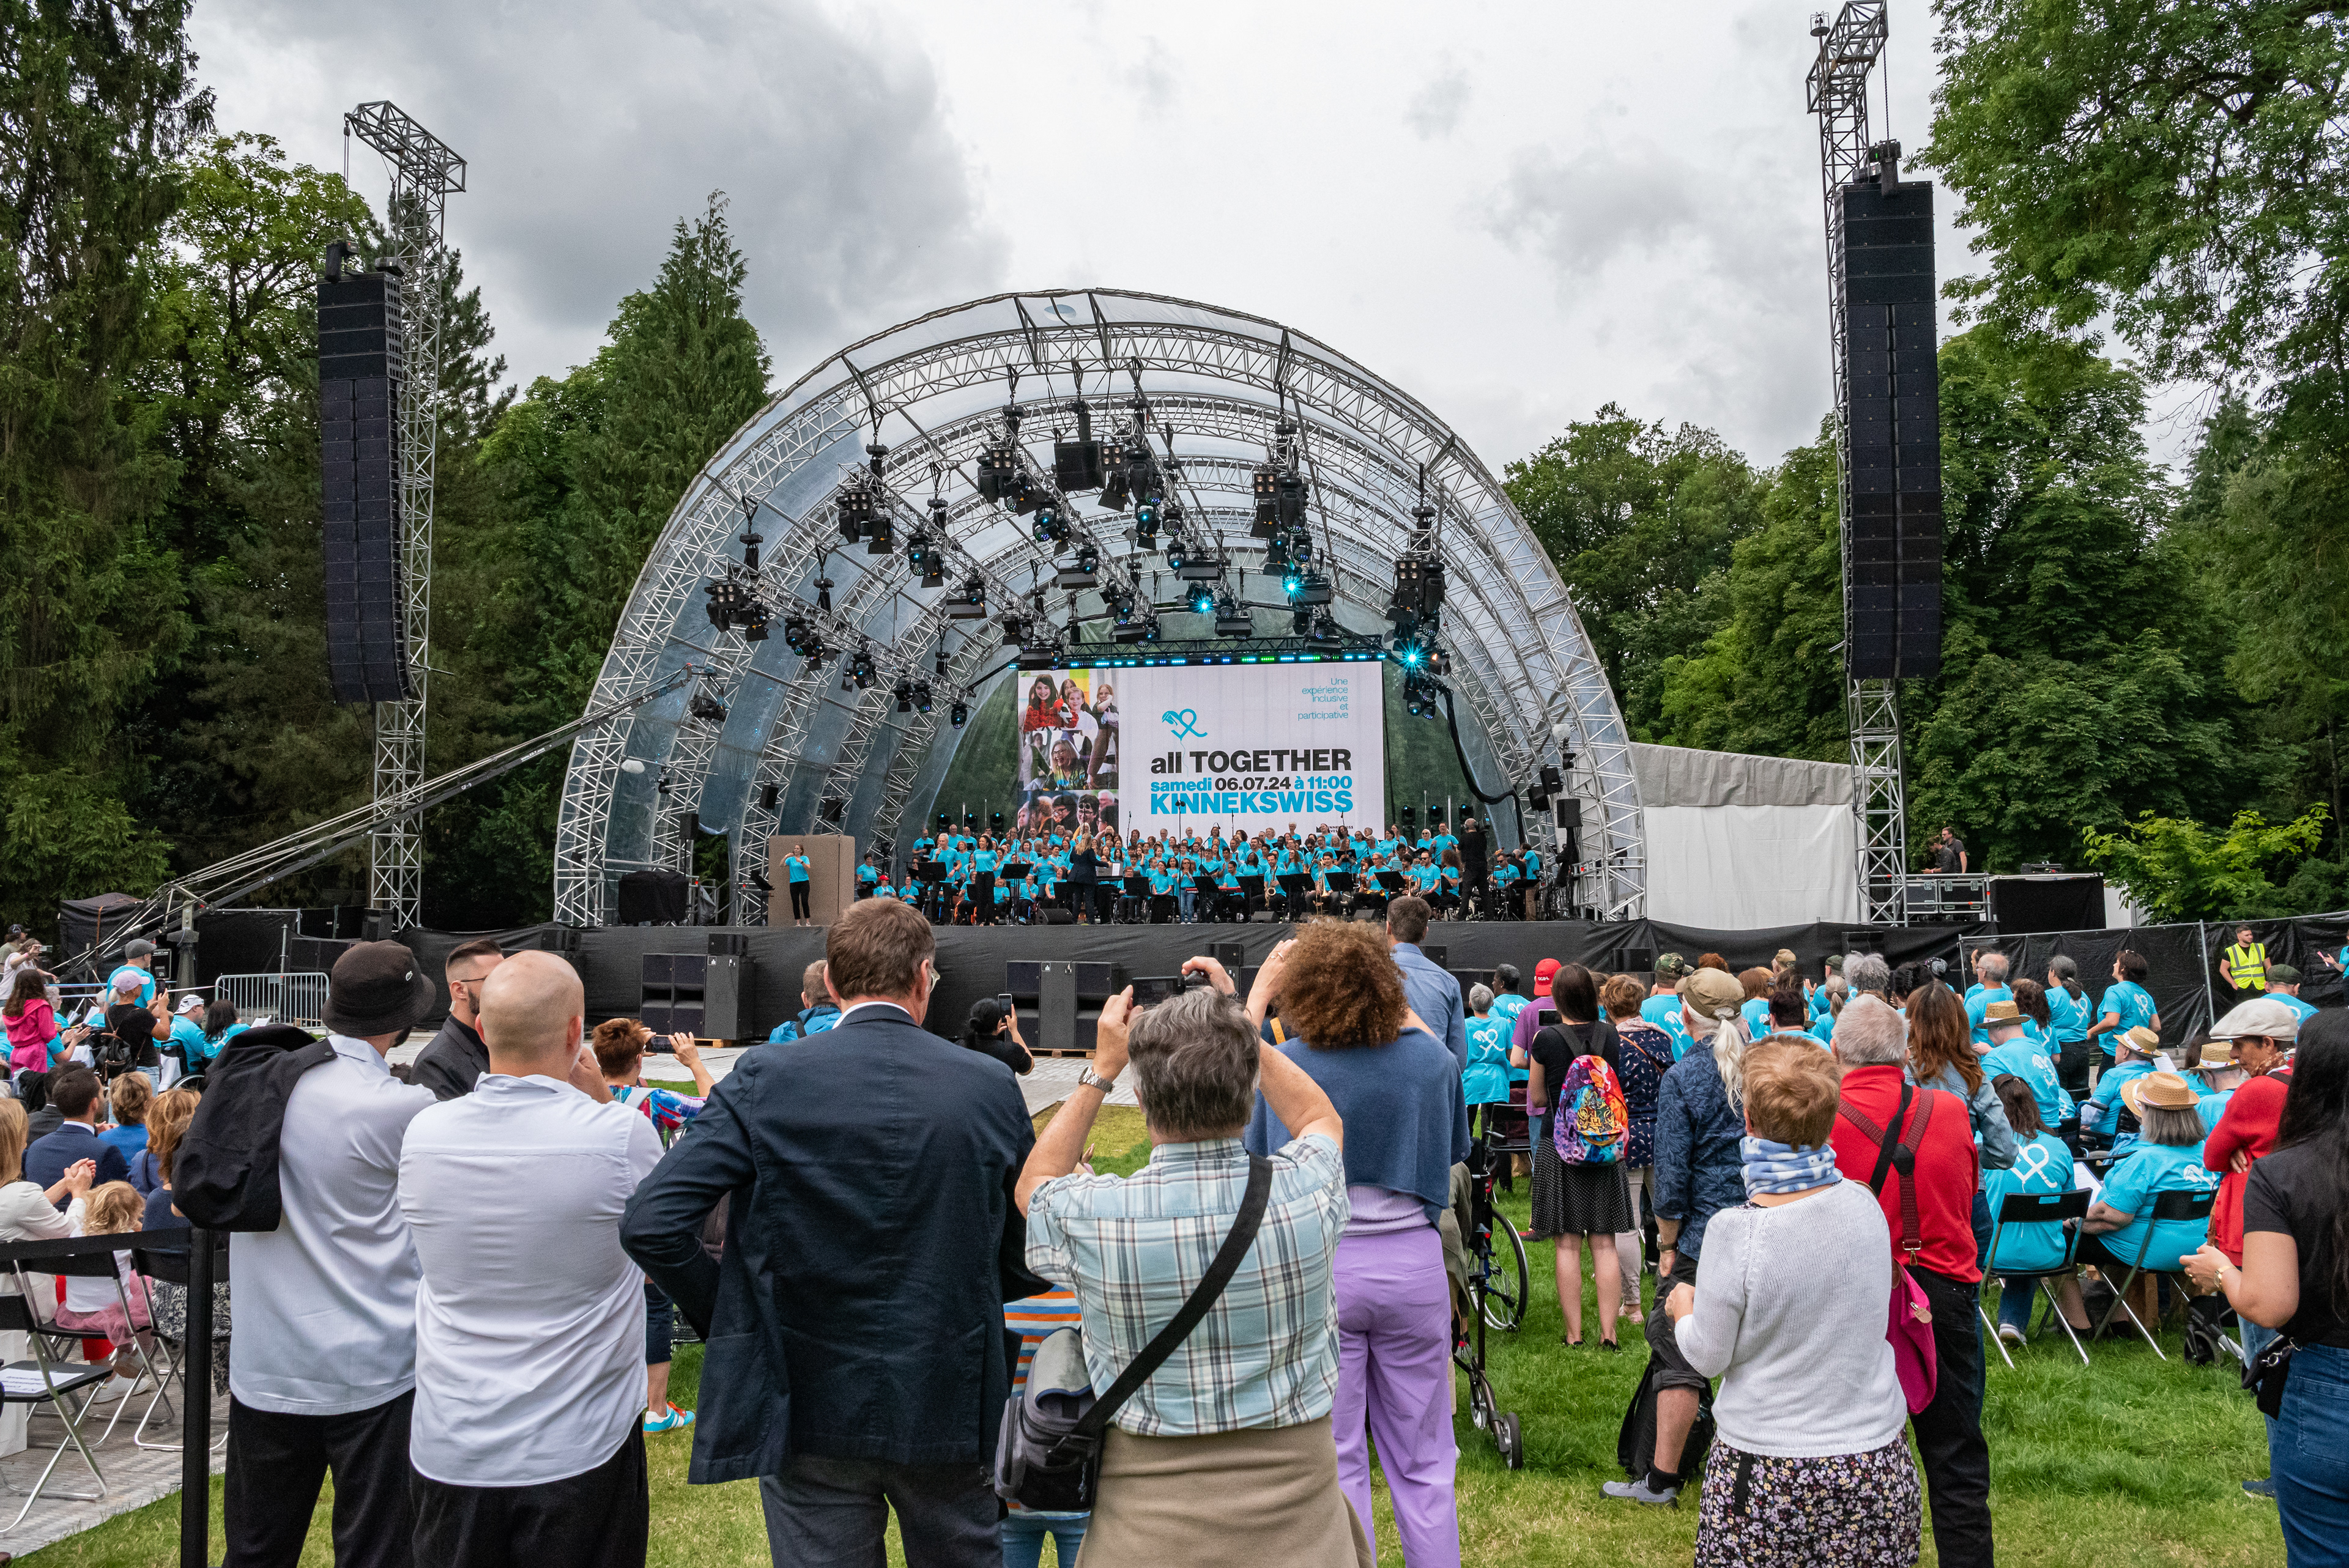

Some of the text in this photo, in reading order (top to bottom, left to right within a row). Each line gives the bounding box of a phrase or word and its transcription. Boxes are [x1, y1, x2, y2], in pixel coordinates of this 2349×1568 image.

[1302, 686, 1348, 696] expérience
[1297, 711, 1348, 721] participative
[1151, 749, 1352, 774] all TOGETHER
[1151, 775, 1353, 792] samedi 06.07.24 à 11:00
[1151, 790, 1353, 815] KINNEKSWISS
